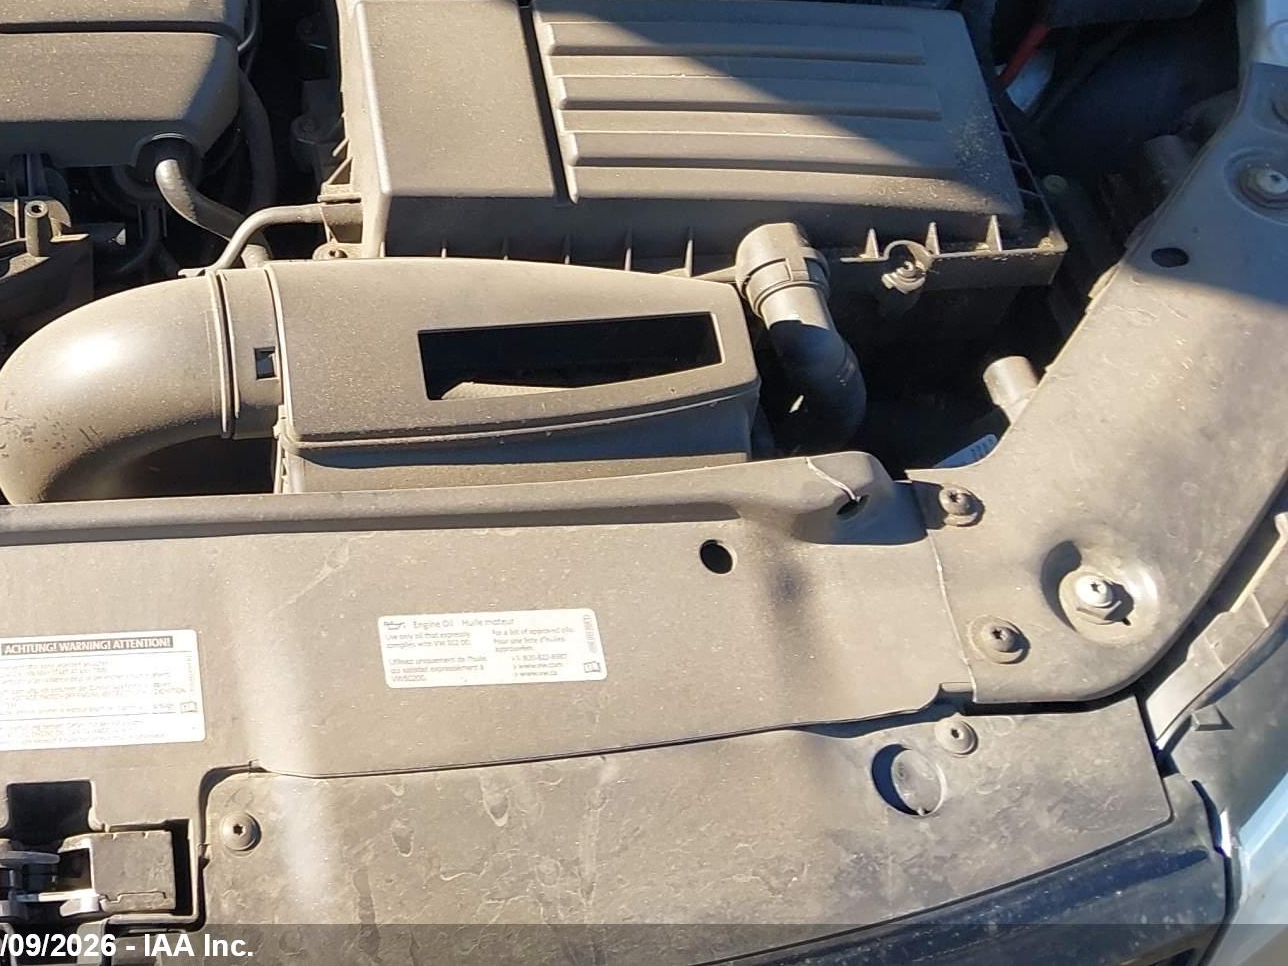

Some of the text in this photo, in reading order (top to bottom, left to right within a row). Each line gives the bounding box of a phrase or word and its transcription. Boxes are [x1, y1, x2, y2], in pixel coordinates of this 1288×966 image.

[413, 621, 441, 630] Engine
[4, 637, 171, 654] ACHTUNG! WARNING! ATTENTION!
